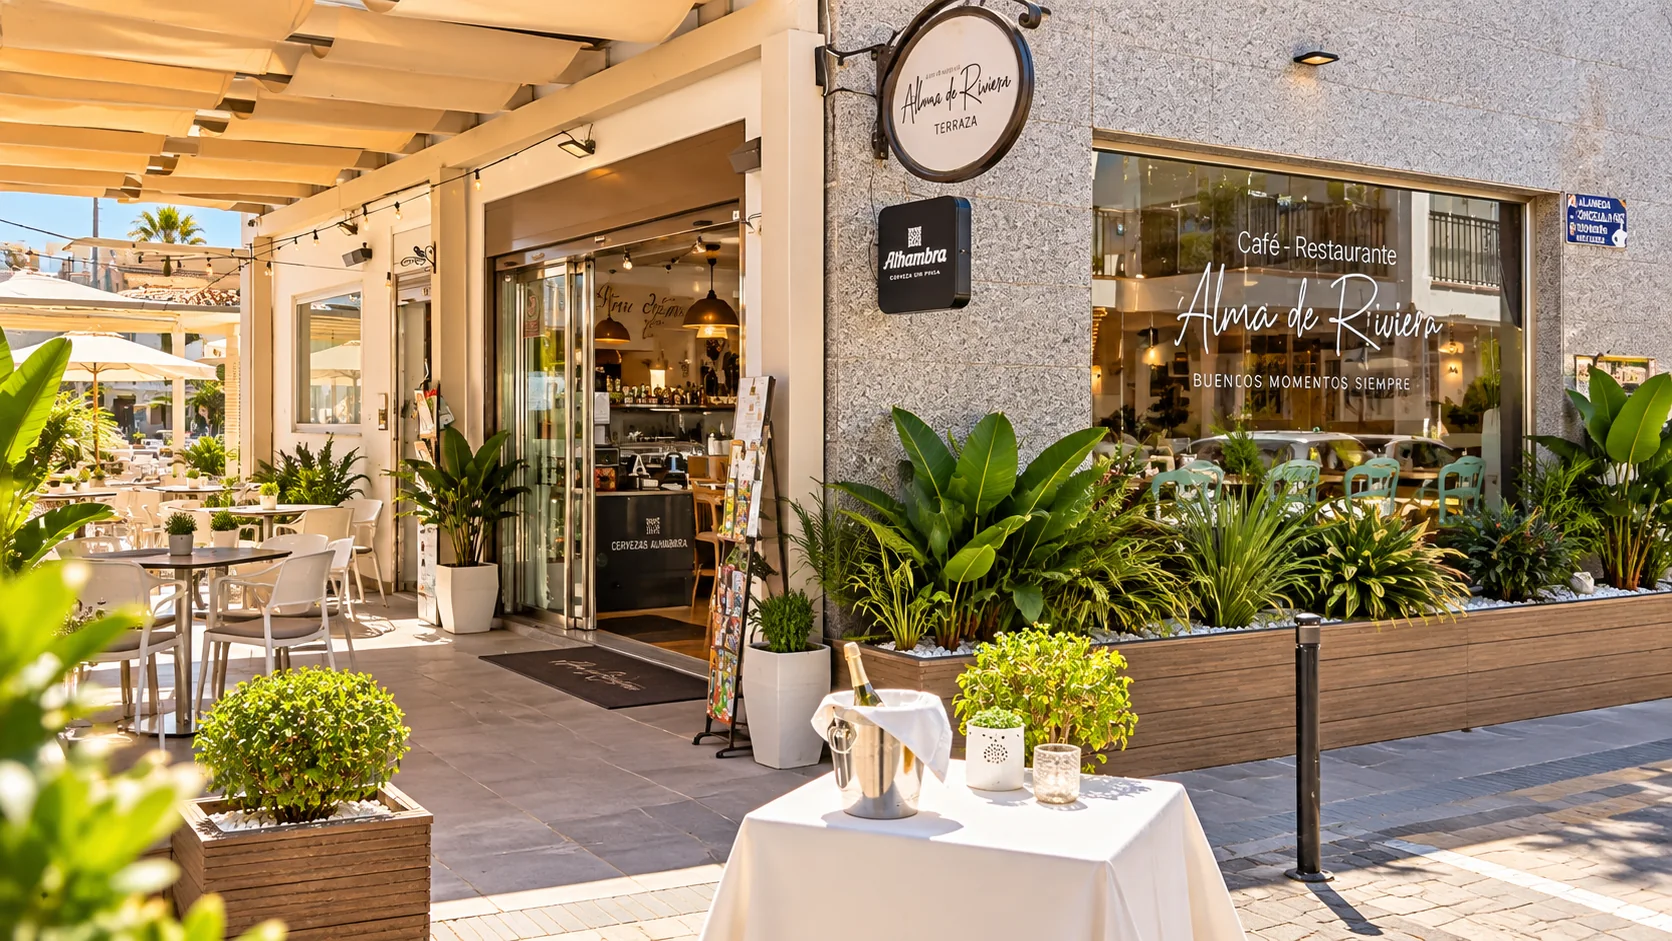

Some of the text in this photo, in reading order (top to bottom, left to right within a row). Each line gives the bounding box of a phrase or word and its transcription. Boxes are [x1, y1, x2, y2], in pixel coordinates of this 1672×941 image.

[945, 76, 958, 112] de
[933, 115, 979, 135] TERRAZA
[883, 246, 948, 270] Alhambra
[1237, 230, 1280, 256] Café
[1295, 235, 1397, 266] Restaurante
[1174, 261, 1444, 357] Alma de Riviera
[1269, 375, 1349, 391] MOMENTOS
[1355, 376, 1411, 391] SIEMPRE
[611, 540, 648, 551] CERVEZAS
